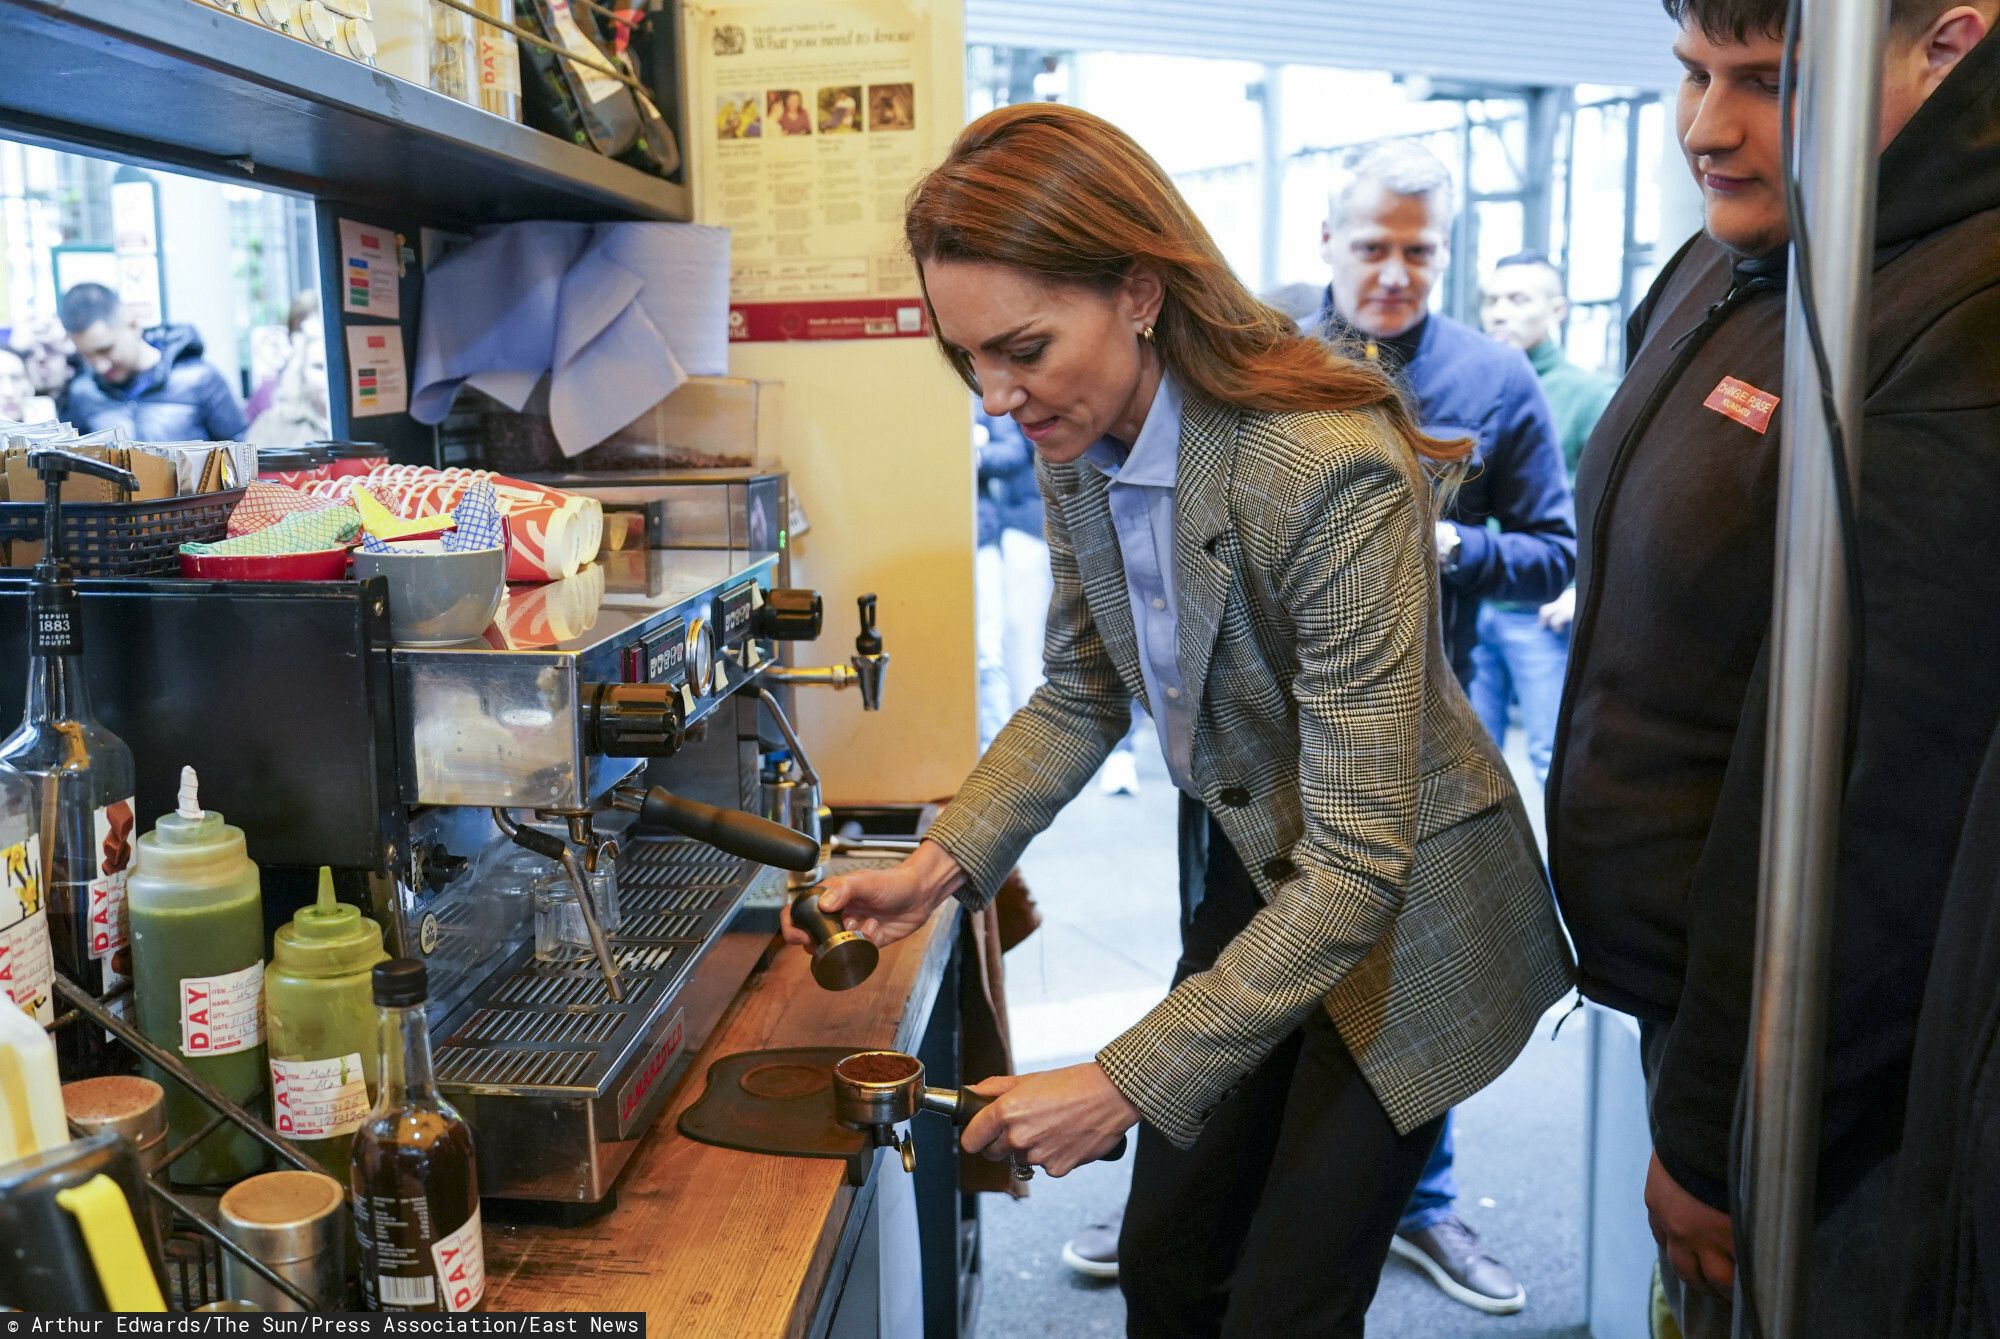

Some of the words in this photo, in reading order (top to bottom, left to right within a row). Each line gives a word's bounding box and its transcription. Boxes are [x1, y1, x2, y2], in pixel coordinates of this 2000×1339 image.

[482, 41, 496, 84] DAY
[753, 36, 790, 50] What
[792, 37, 818, 53] you
[820, 31, 851, 46] need
[854, 32, 870, 45] to
[874, 29, 914, 43] know
[40, 620, 70, 632] 1883
[94, 888, 109, 951] DAY
[188, 988, 209, 1049] DAY
[212, 1023, 228, 1031] DATE
[273, 1068, 293, 1131] DAY
[441, 1247, 472, 1309] DAY
